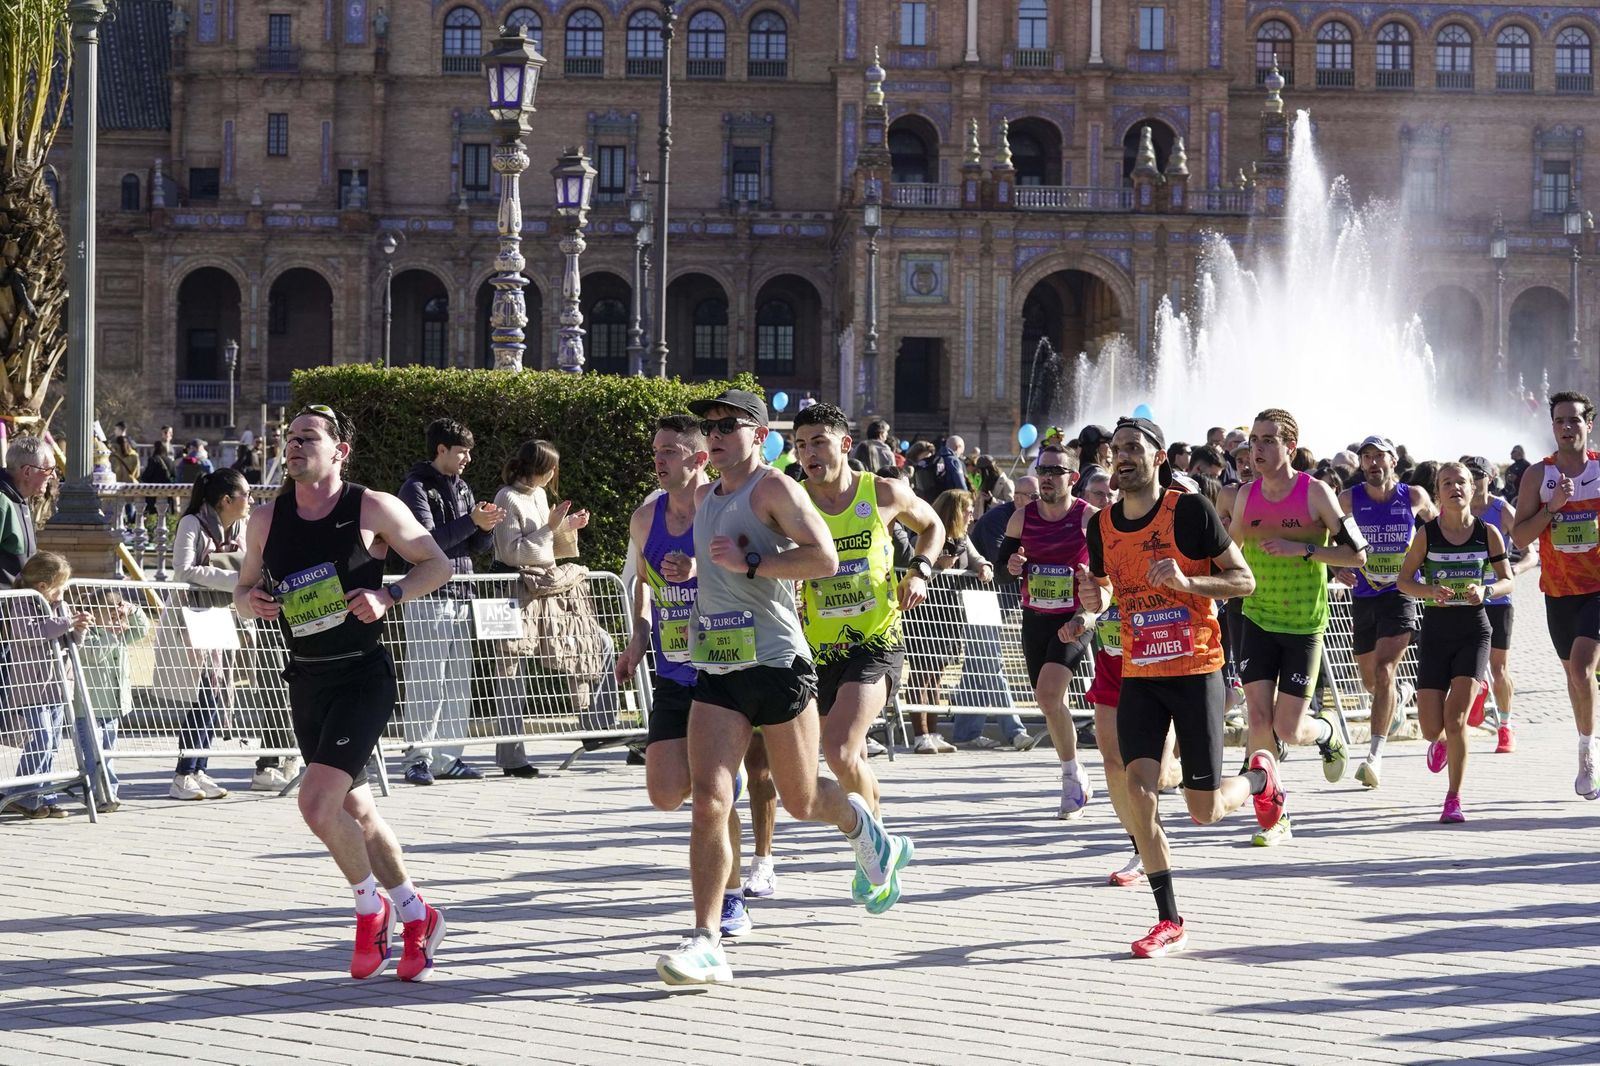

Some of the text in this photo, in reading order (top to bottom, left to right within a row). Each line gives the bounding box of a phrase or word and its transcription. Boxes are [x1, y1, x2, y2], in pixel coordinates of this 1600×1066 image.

[1566, 513, 1592, 521] ZURICH
[1385, 523, 1408, 533] CHATOU
[1363, 532, 1408, 543] THLETISME
[1567, 534, 1583, 543] TIM
[1376, 545, 1401, 553] ZURICH
[1043, 567, 1068, 575] ZURICH
[1368, 564, 1402, 573] MATHIEU
[291, 567, 328, 587] ZURICH
[833, 581, 851, 592] 1945
[299, 591, 318, 604] 1944
[824, 590, 866, 608] AITANA
[1031, 588, 1070, 599] MIGUE JR
[286, 599, 347, 626] CATHAL LACEY
[486, 603, 512, 621] AMS
[1147, 610, 1182, 623] ZURICH
[713, 616, 745, 627] ZURICH
[1108, 634, 1122, 646] RU
[1152, 630, 1169, 640] 1029
[1142, 639, 1183, 656] JAVIER
[708, 648, 740, 662] MARK
